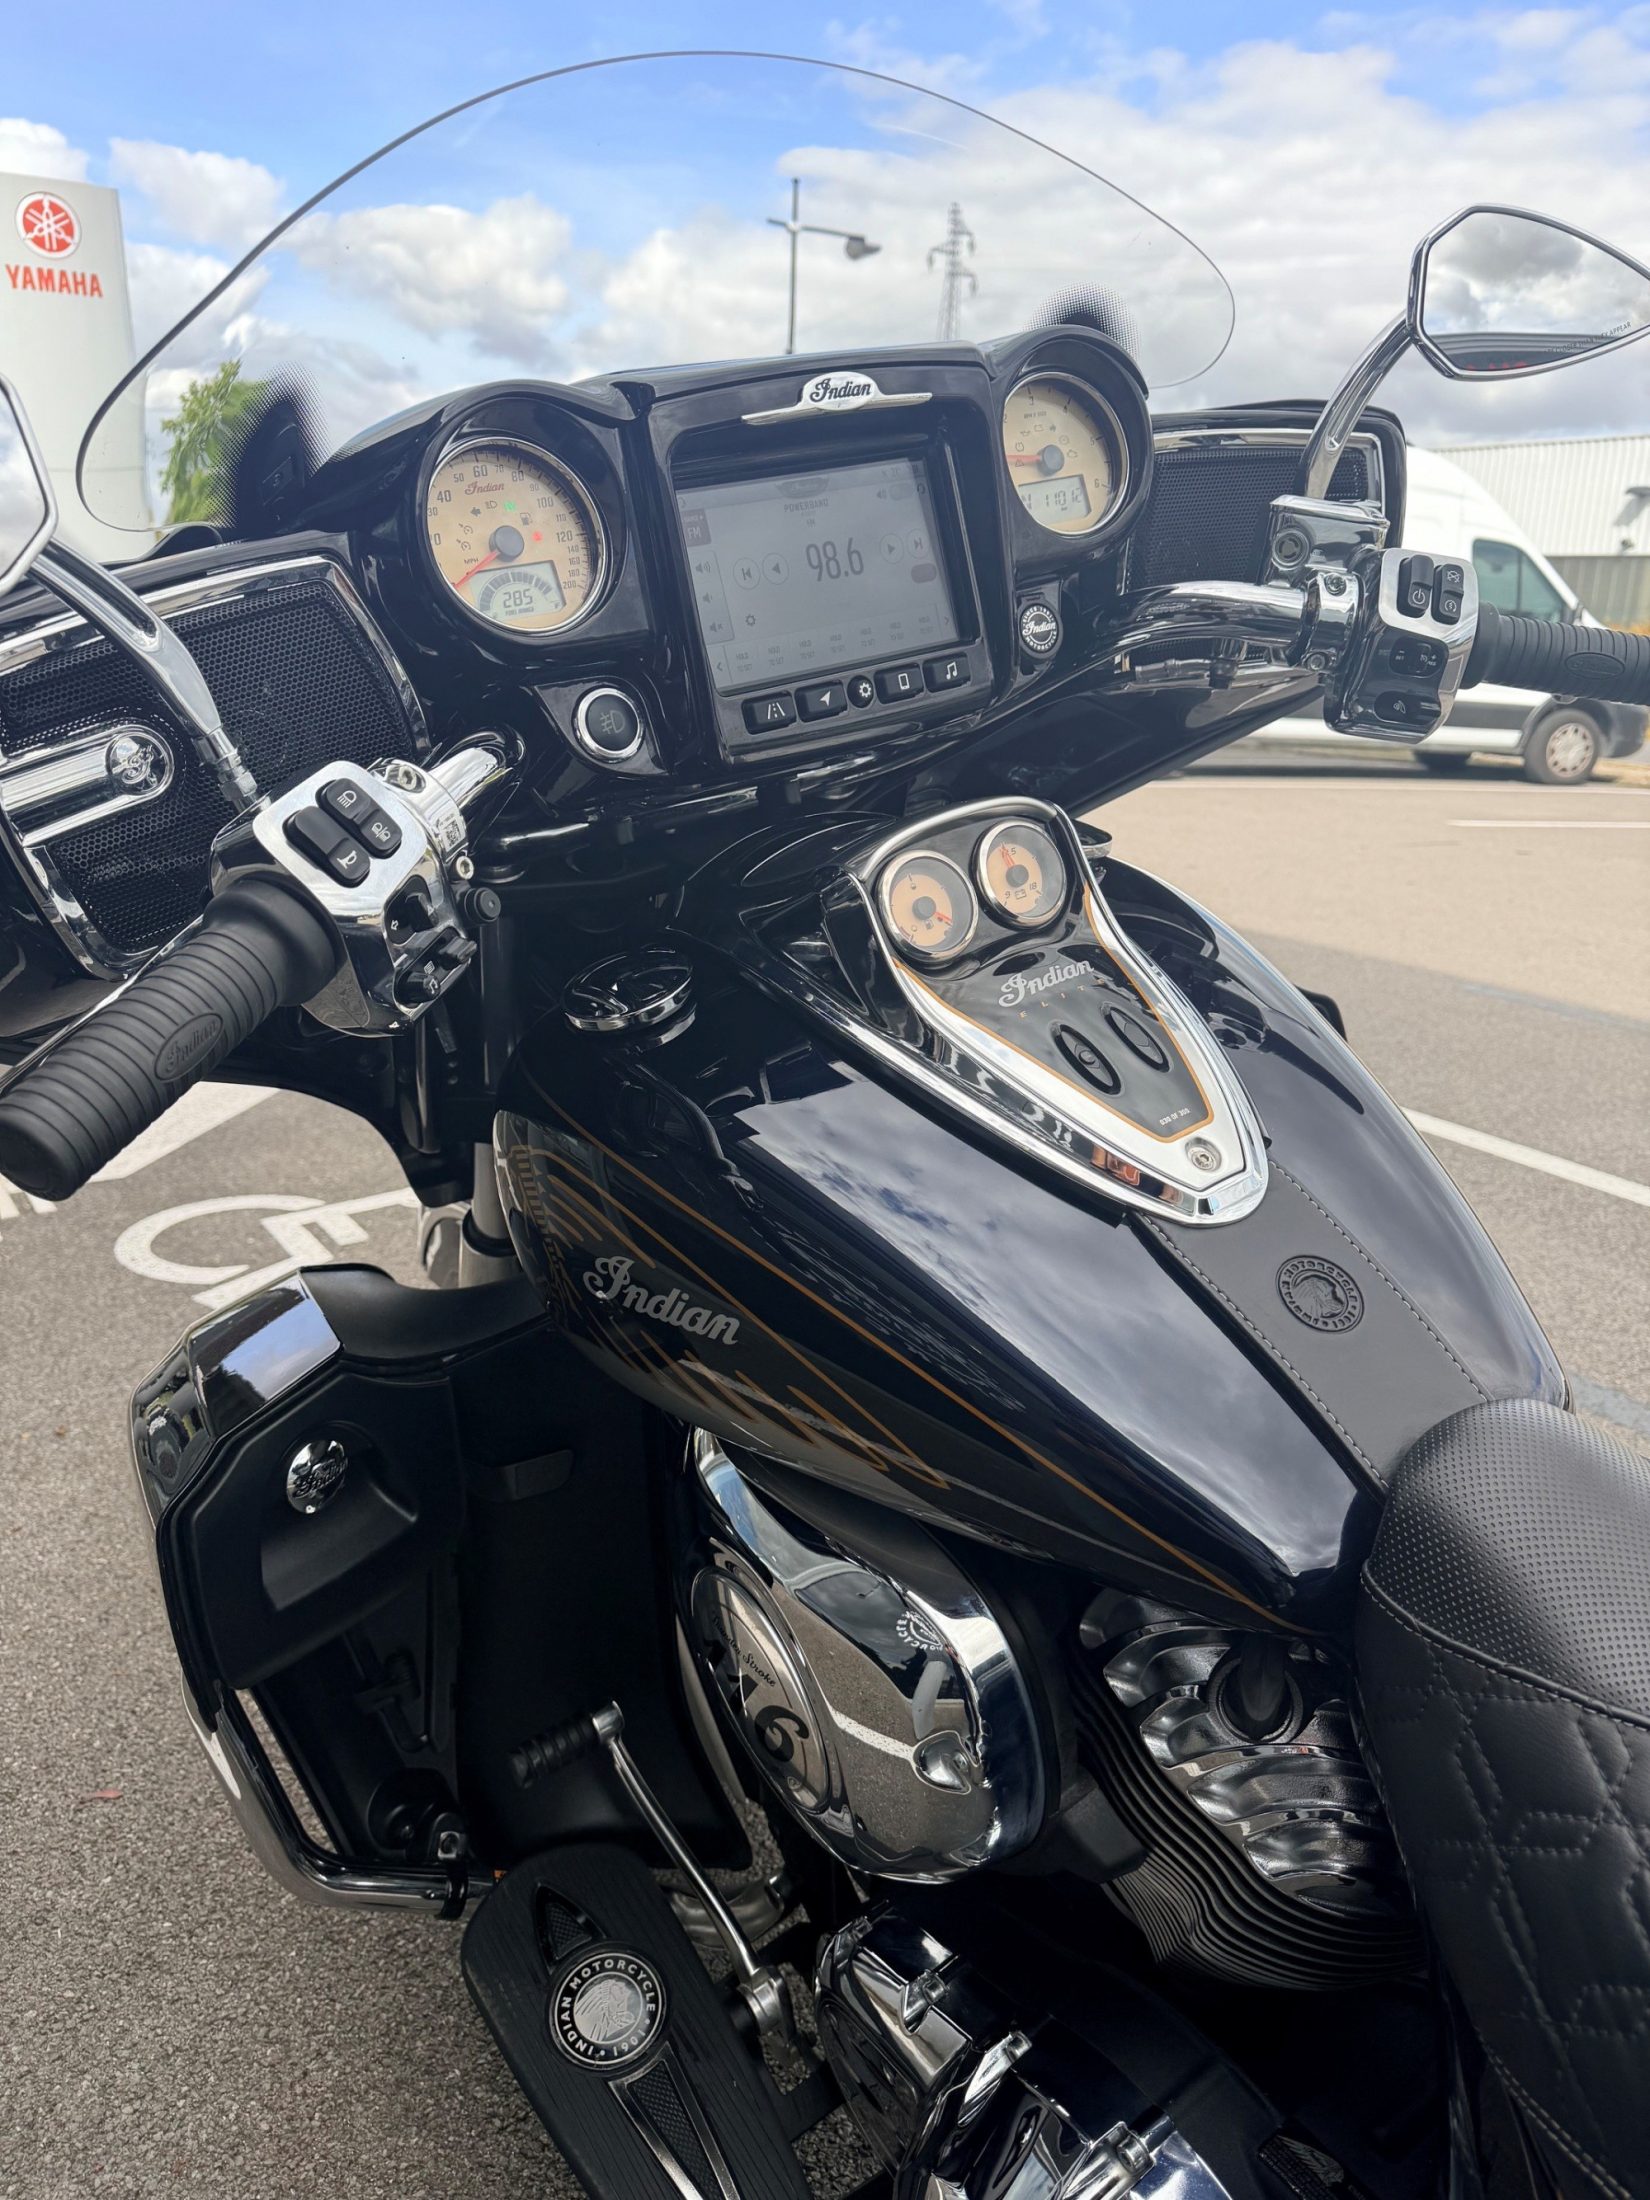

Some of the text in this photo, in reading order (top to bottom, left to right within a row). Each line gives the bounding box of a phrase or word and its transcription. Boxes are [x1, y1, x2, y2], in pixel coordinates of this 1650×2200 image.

[5, 263, 104, 298] YAMAHA
[1610, 321, 1632, 334] APPEAR
[809, 378, 872, 403] Indian
[1090, 436, 1096, 447] 5
[473, 464, 488, 478] 60
[495, 464, 504, 473] 70
[453, 473, 465, 483] 50
[511, 470, 525, 482] 80
[464, 481, 505, 496] Indian
[529, 483, 540, 492] 90
[1094, 478, 1100, 488] 6
[437, 489, 452, 503] 40
[536, 496, 554, 509] 100
[427, 506, 438, 517] 30
[556, 513, 567, 522] 110
[556, 530, 573, 543] 120
[687, 526, 702, 540] FM
[567, 545, 579, 554] 140
[568, 556, 580, 566] 160
[806, 537, 864, 582] 98.6
[562, 580, 577, 590] 200
[503, 588, 534, 609] 285
[1022, 620, 1056, 636] Indian
[1029, 882, 1037, 890] 18
[1004, 890, 1011, 899] 9
[999, 960, 1095, 1007] Indian
[1018, 978, 1106, 1019] ELITE
[583, 1255, 741, 1346] Indian
[742, 1651, 777, 1688] Stroke
[560, 1958, 656, 2056] INDIAN MOTORCYCLE
[612, 2028, 647, 2057] 1901
